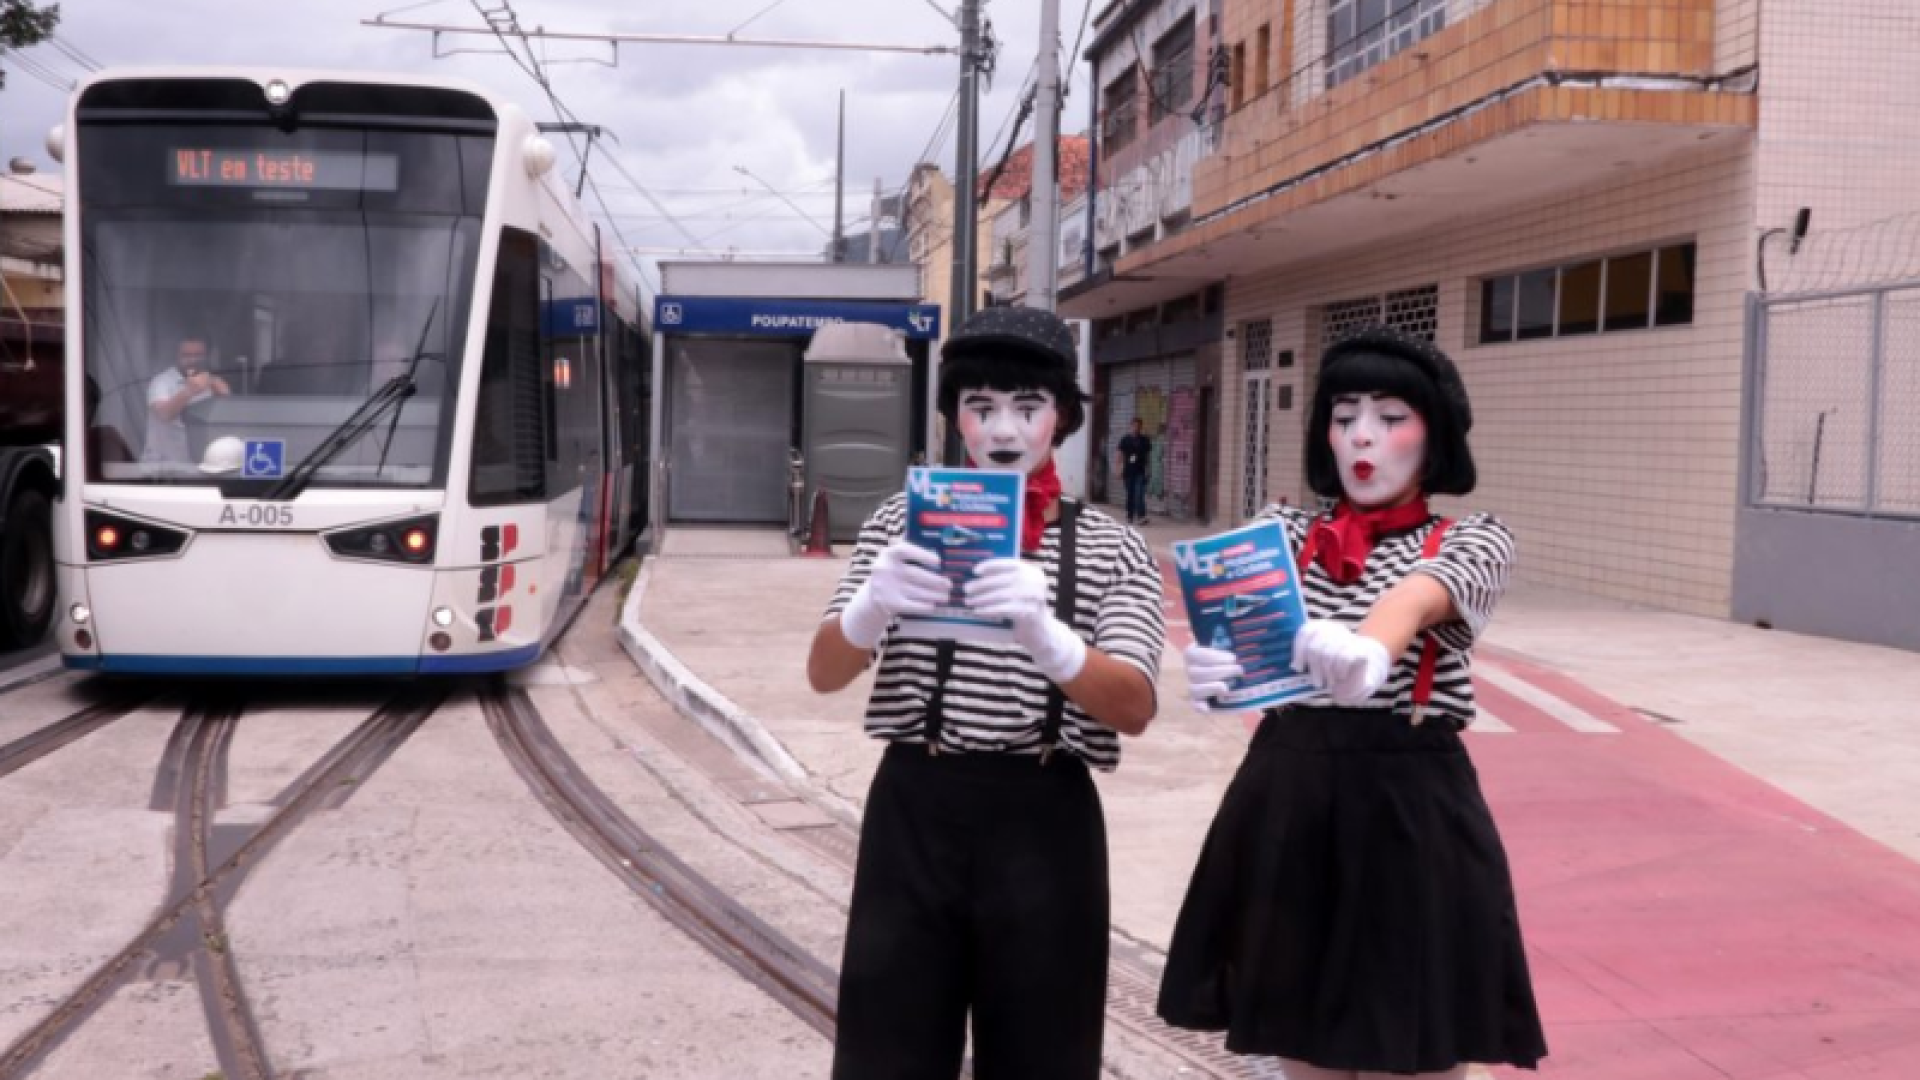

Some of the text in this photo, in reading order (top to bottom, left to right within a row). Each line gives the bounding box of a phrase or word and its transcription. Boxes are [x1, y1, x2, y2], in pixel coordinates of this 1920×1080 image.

[177, 149, 314, 181] VLT em teste
[218, 503, 294, 525] A-005
